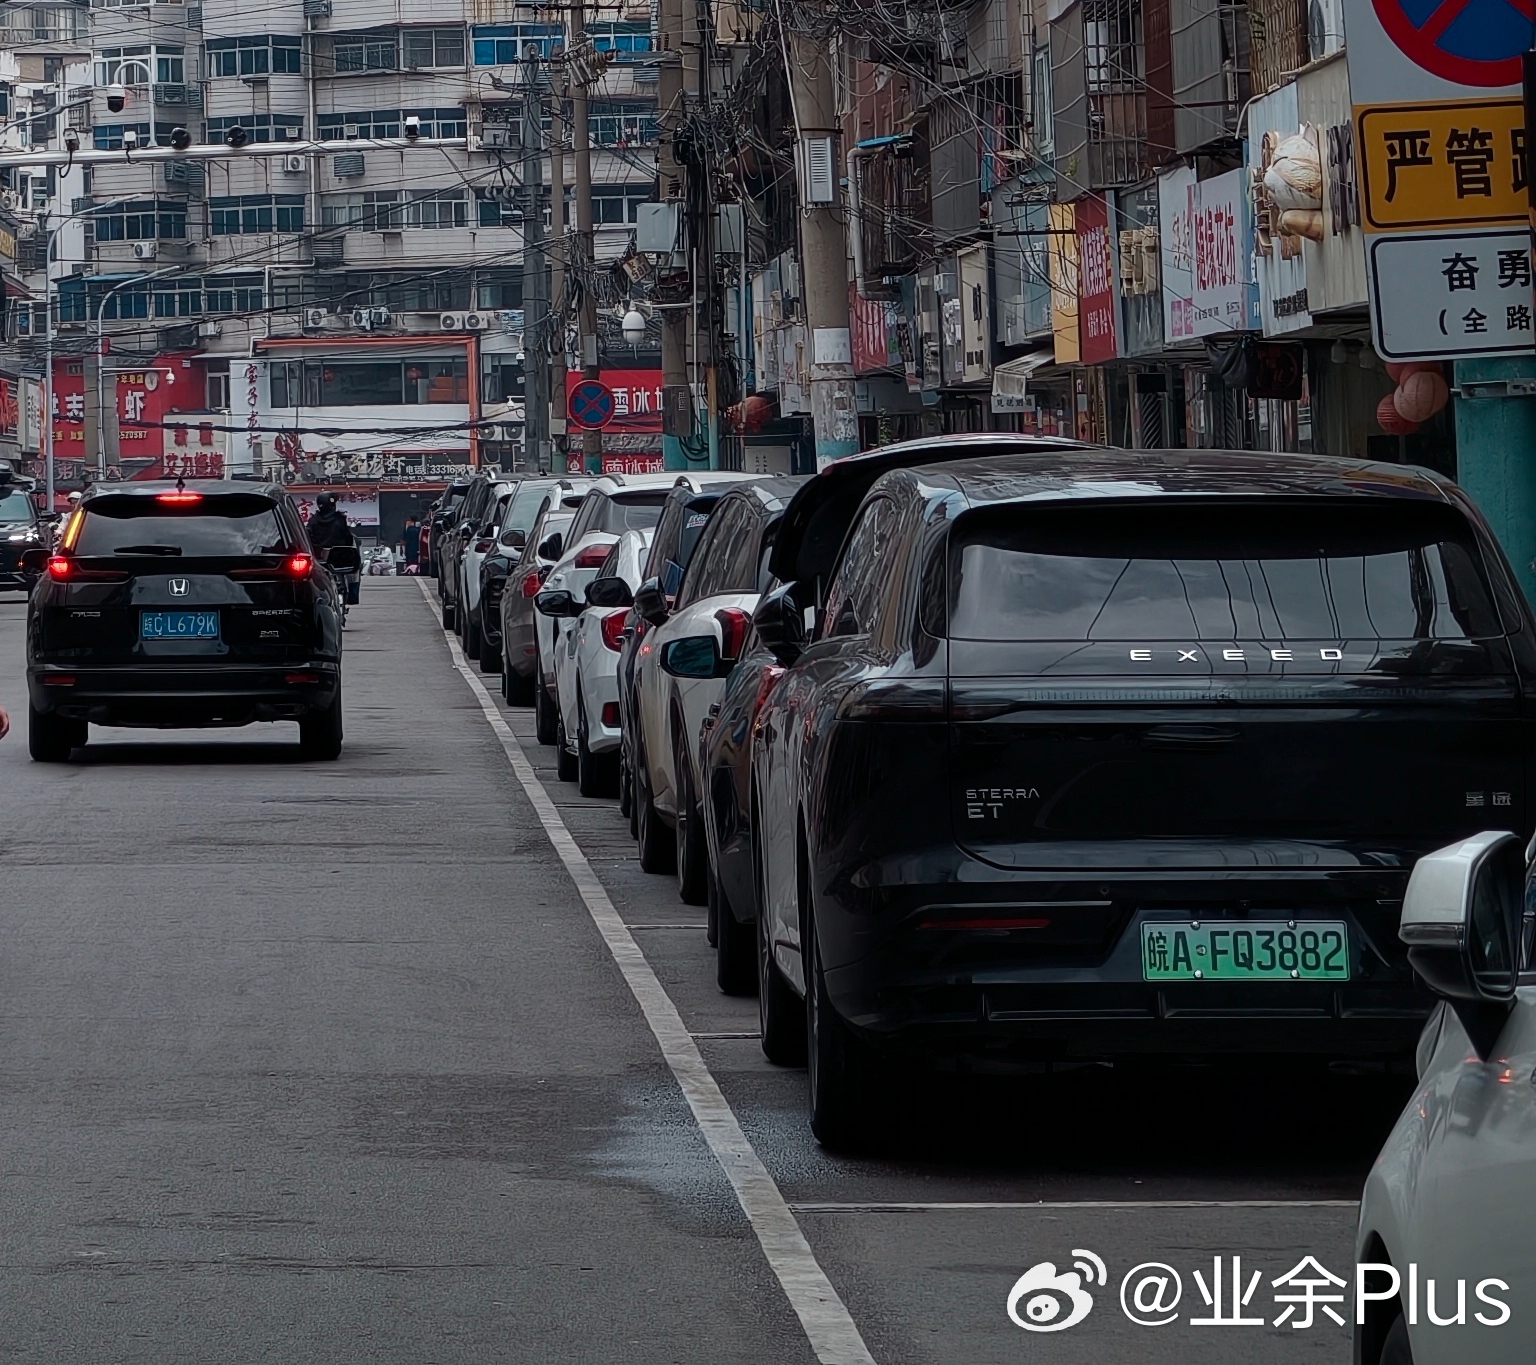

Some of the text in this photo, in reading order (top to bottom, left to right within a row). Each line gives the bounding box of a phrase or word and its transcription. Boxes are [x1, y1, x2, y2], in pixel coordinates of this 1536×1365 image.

[1441, 249, 1531, 292] 奋勇
[602, 458, 663, 474] 雪冰城
[1129, 648, 1343, 662] EXEED
[965, 787, 1040, 800] STERRA
[966, 802, 1004, 819] ET
